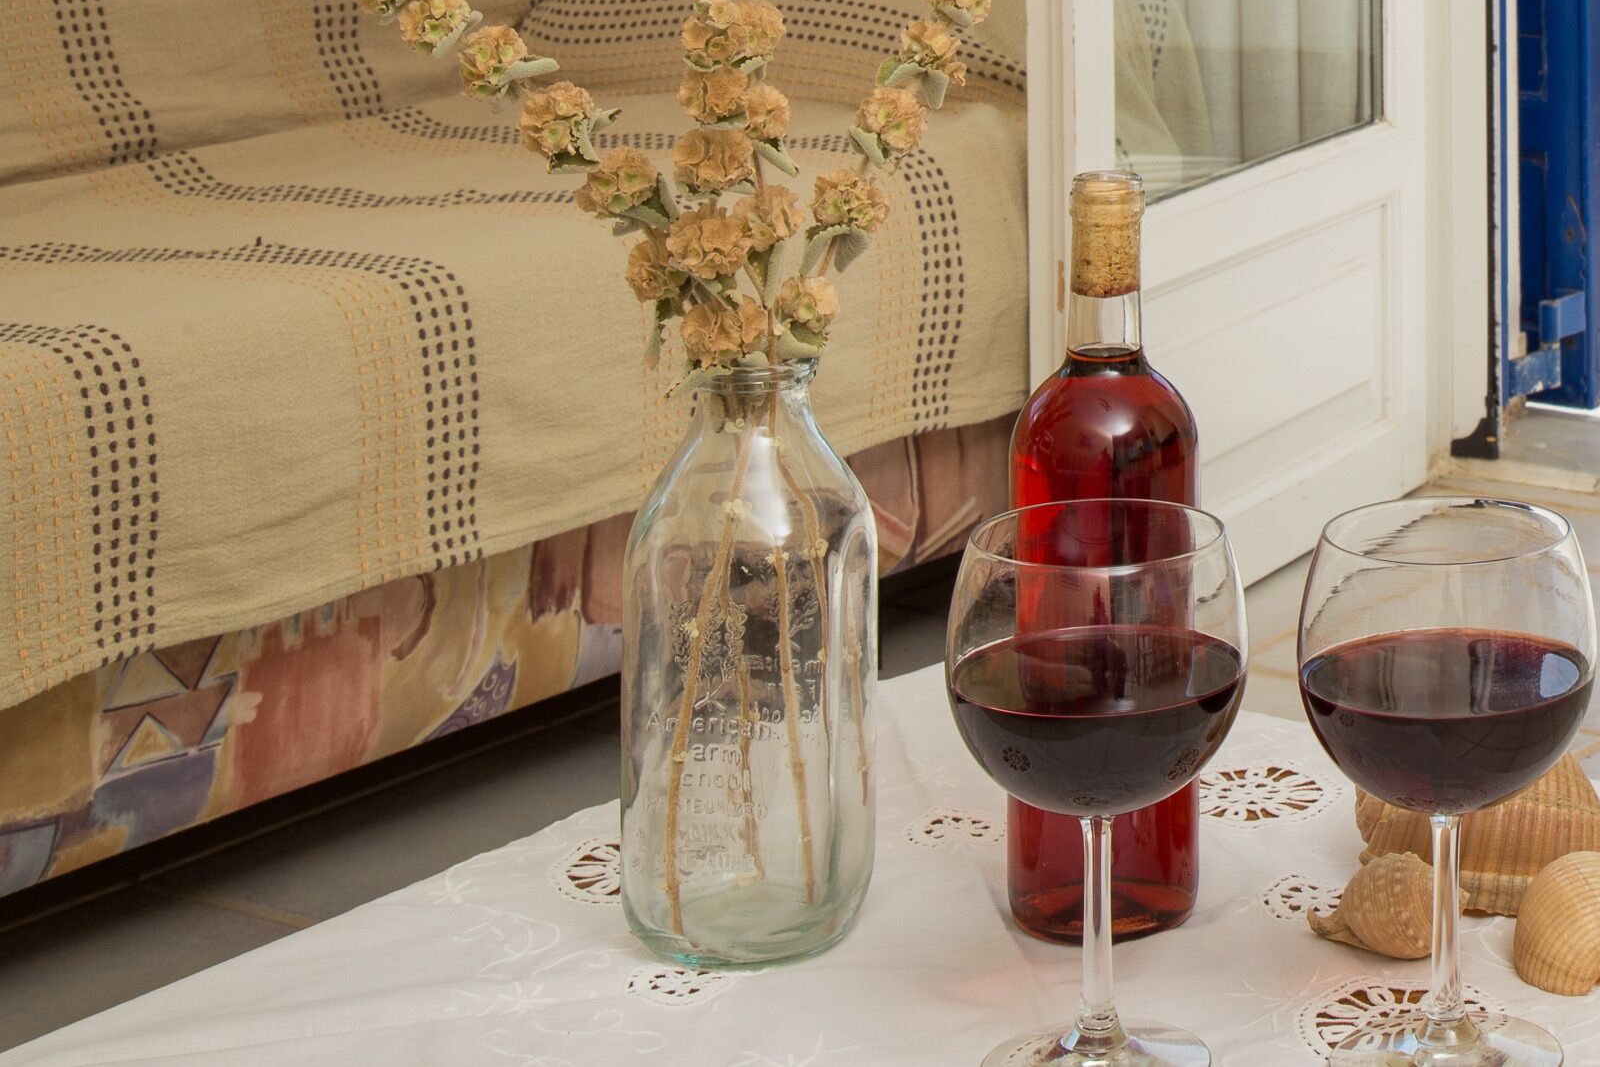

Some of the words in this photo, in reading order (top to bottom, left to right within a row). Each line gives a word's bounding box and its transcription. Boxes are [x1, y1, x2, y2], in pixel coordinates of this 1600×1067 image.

[690, 741, 742, 766] arm
[681, 769, 752, 793] chool
[686, 820, 738, 844] MILK
